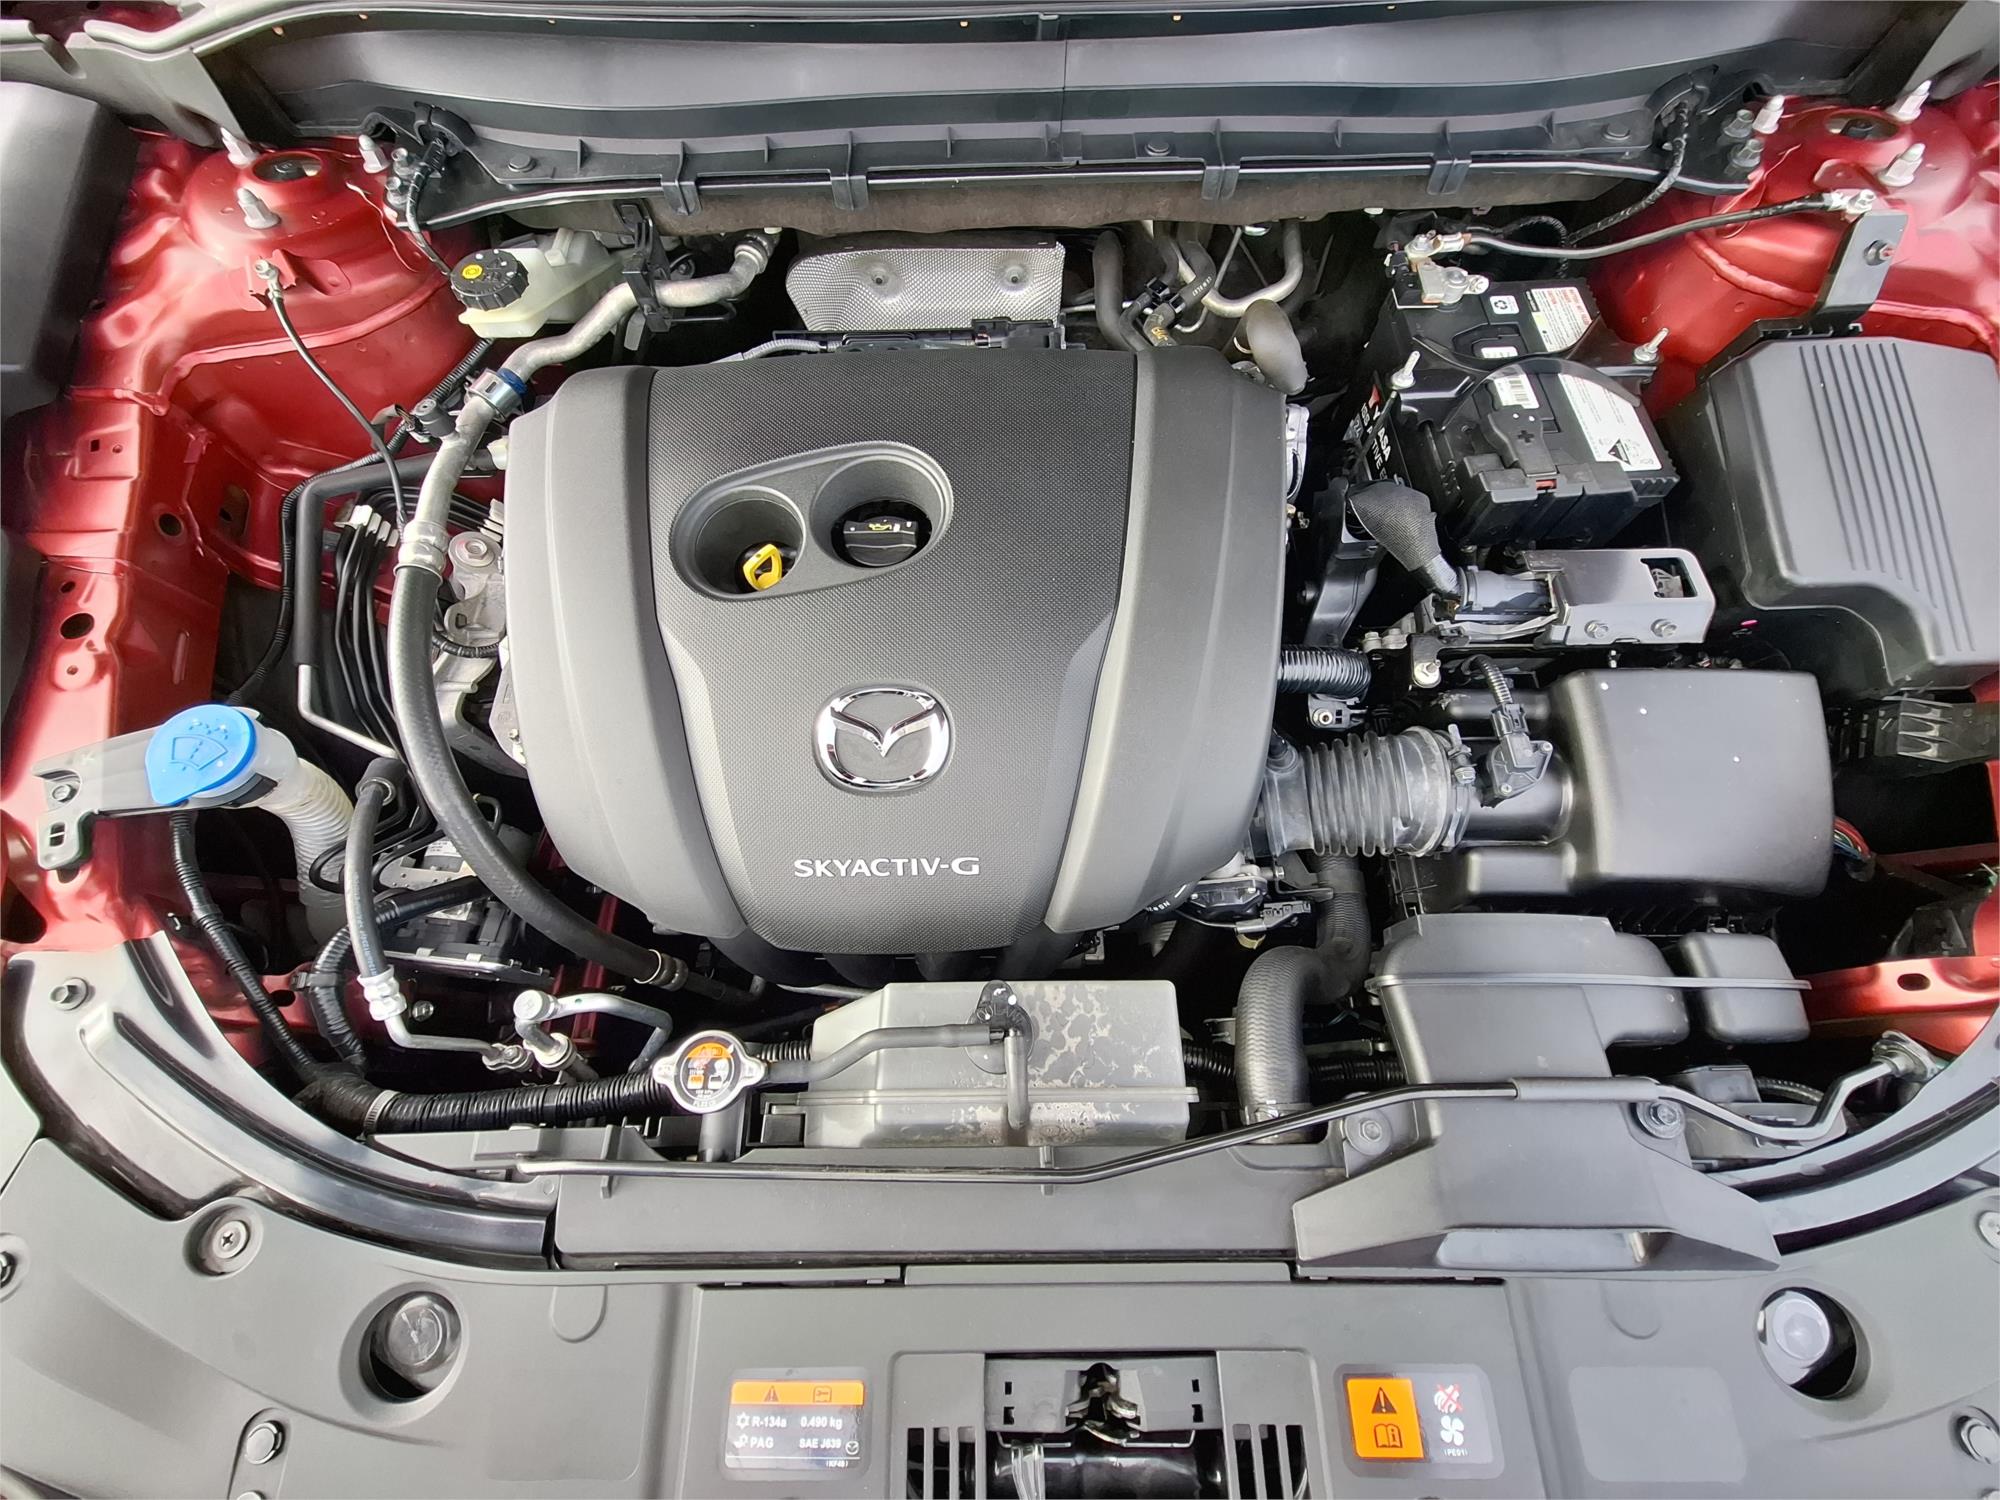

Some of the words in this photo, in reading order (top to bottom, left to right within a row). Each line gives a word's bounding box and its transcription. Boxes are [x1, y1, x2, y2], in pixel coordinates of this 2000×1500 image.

[1373, 405, 1391, 462] YASA
[794, 856, 980, 878] SKYACTIV-G
[751, 1416, 787, 1428] R-134a
[800, 1416, 827, 1428] 0.490
[829, 1416, 842, 1430] kg
[750, 1437, 774, 1448] PAG
[799, 1438, 819, 1448] SAE
